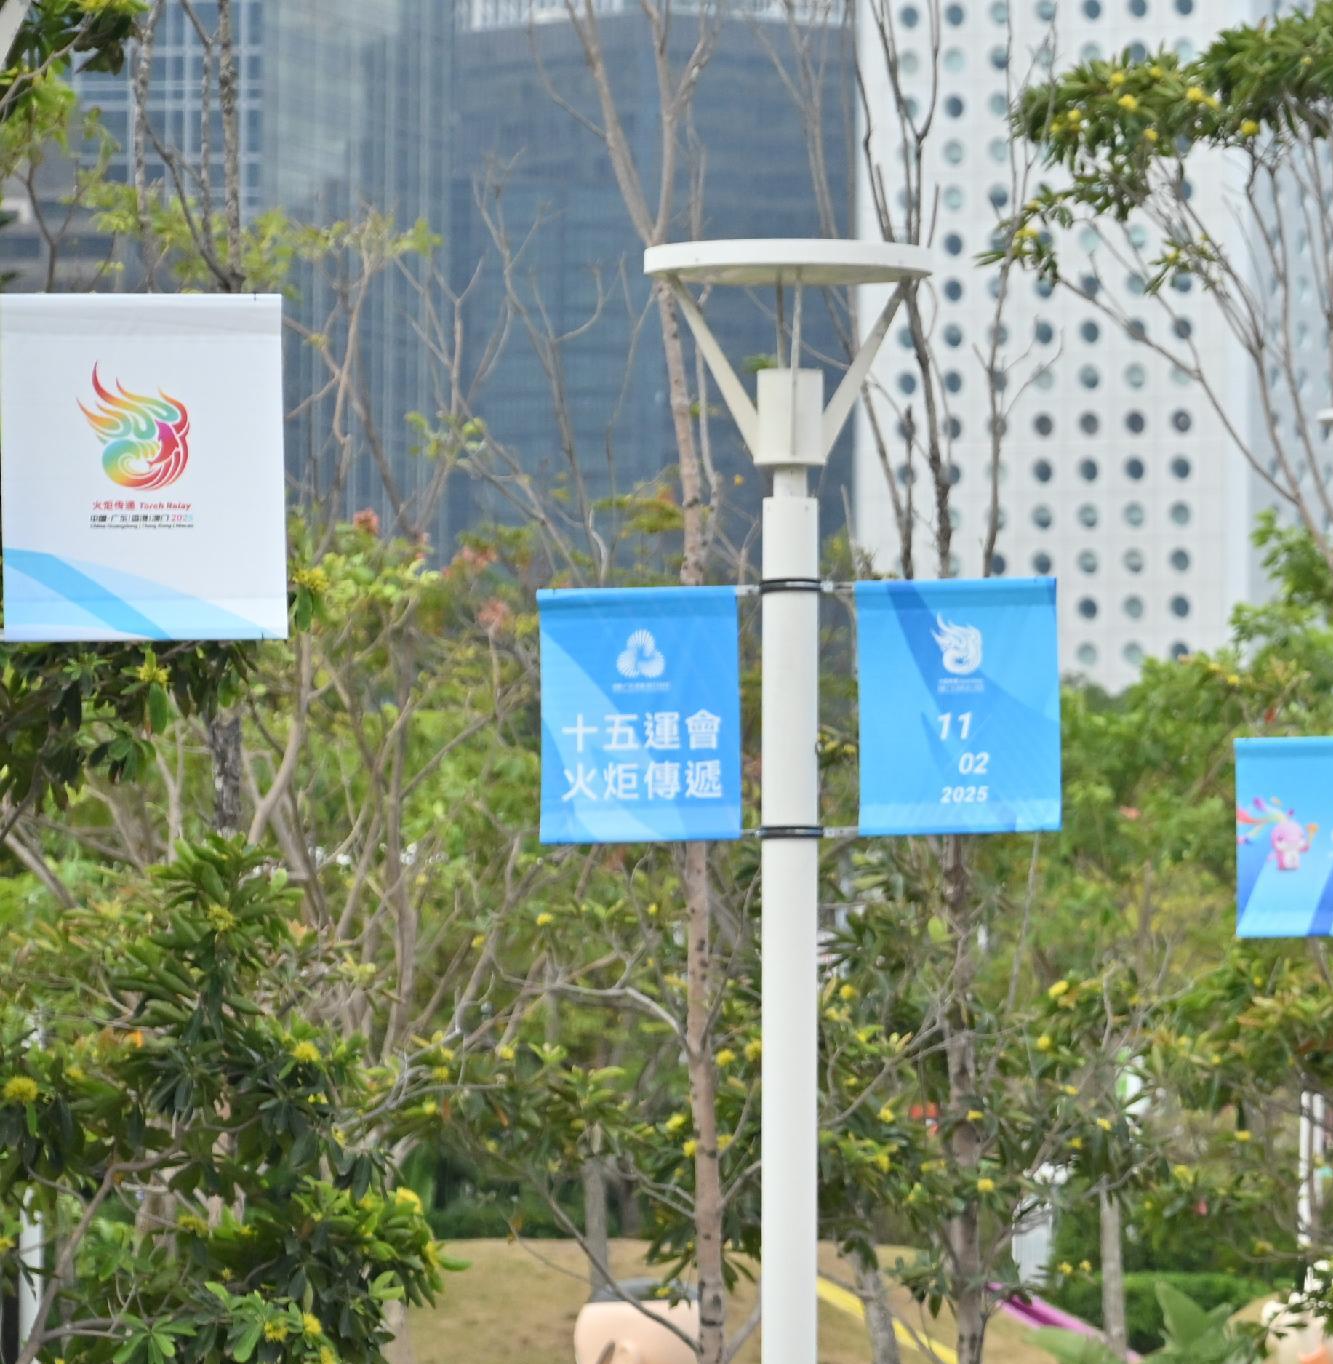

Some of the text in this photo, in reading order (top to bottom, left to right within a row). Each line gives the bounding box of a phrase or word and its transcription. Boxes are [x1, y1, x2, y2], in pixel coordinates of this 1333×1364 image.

[561, 709, 721, 753] 十五運會
[937, 711, 973, 741] 11
[958, 751, 990, 775] 02
[561, 759, 722, 801] 火炬傳遞
[940, 785, 989, 804] 2025
